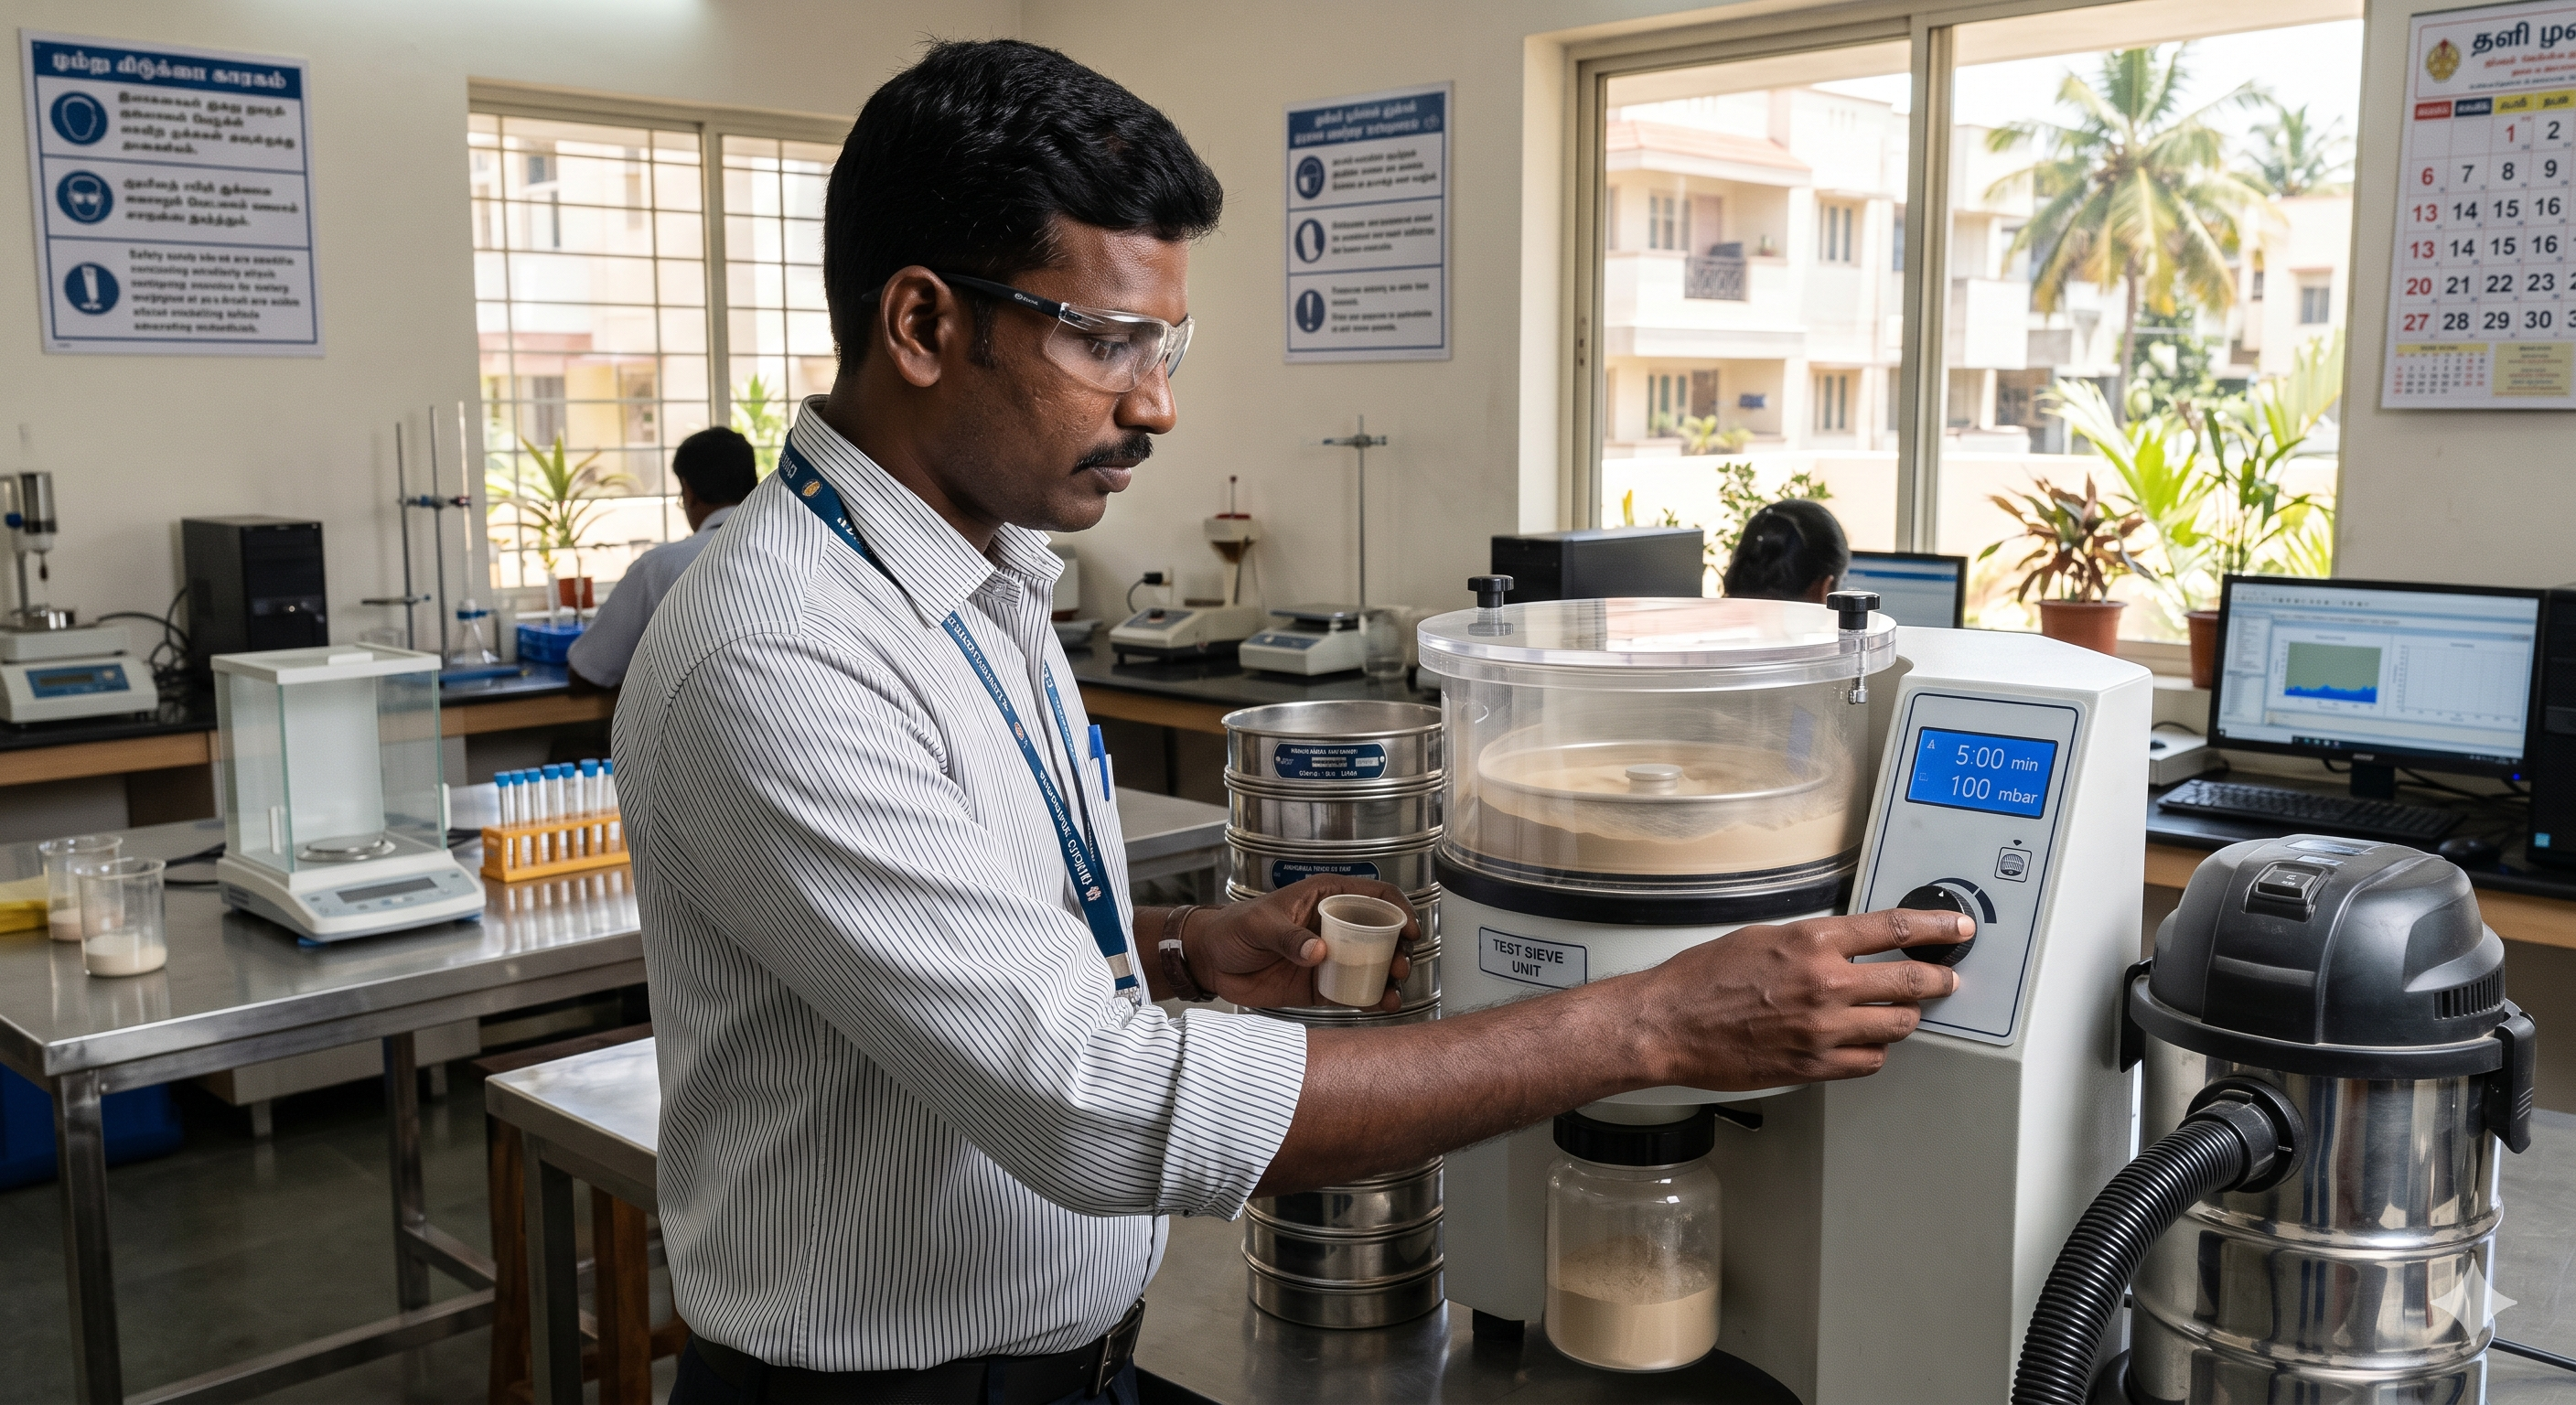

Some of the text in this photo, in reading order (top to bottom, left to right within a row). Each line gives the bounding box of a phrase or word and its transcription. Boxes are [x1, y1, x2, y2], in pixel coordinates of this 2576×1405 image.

[2471, 21, 2530, 58] தளி
[2506, 121, 2561, 143] 1 2
[2420, 159, 2559, 186] 6 7 8 9
[2413, 197, 2561, 222] 13 14 15 16
[2410, 234, 2558, 259] 13 14 15 16
[2405, 277, 2432, 295] 20
[2445, 276, 2470, 295] 21
[2485, 274, 2513, 293] 22
[2527, 273, 2555, 291] 23
[2403, 313, 2431, 331] 27
[2443, 312, 2470, 330] 28
[2484, 311, 2510, 329] 29
[2525, 310, 2552, 329] 30
[1955, 745, 2039, 772] 5:00 min
[1951, 775, 2038, 804] 100 mbar
[1493, 938, 1564, 964] TEST SIEVE
[1512, 960, 1541, 977] UNIT
